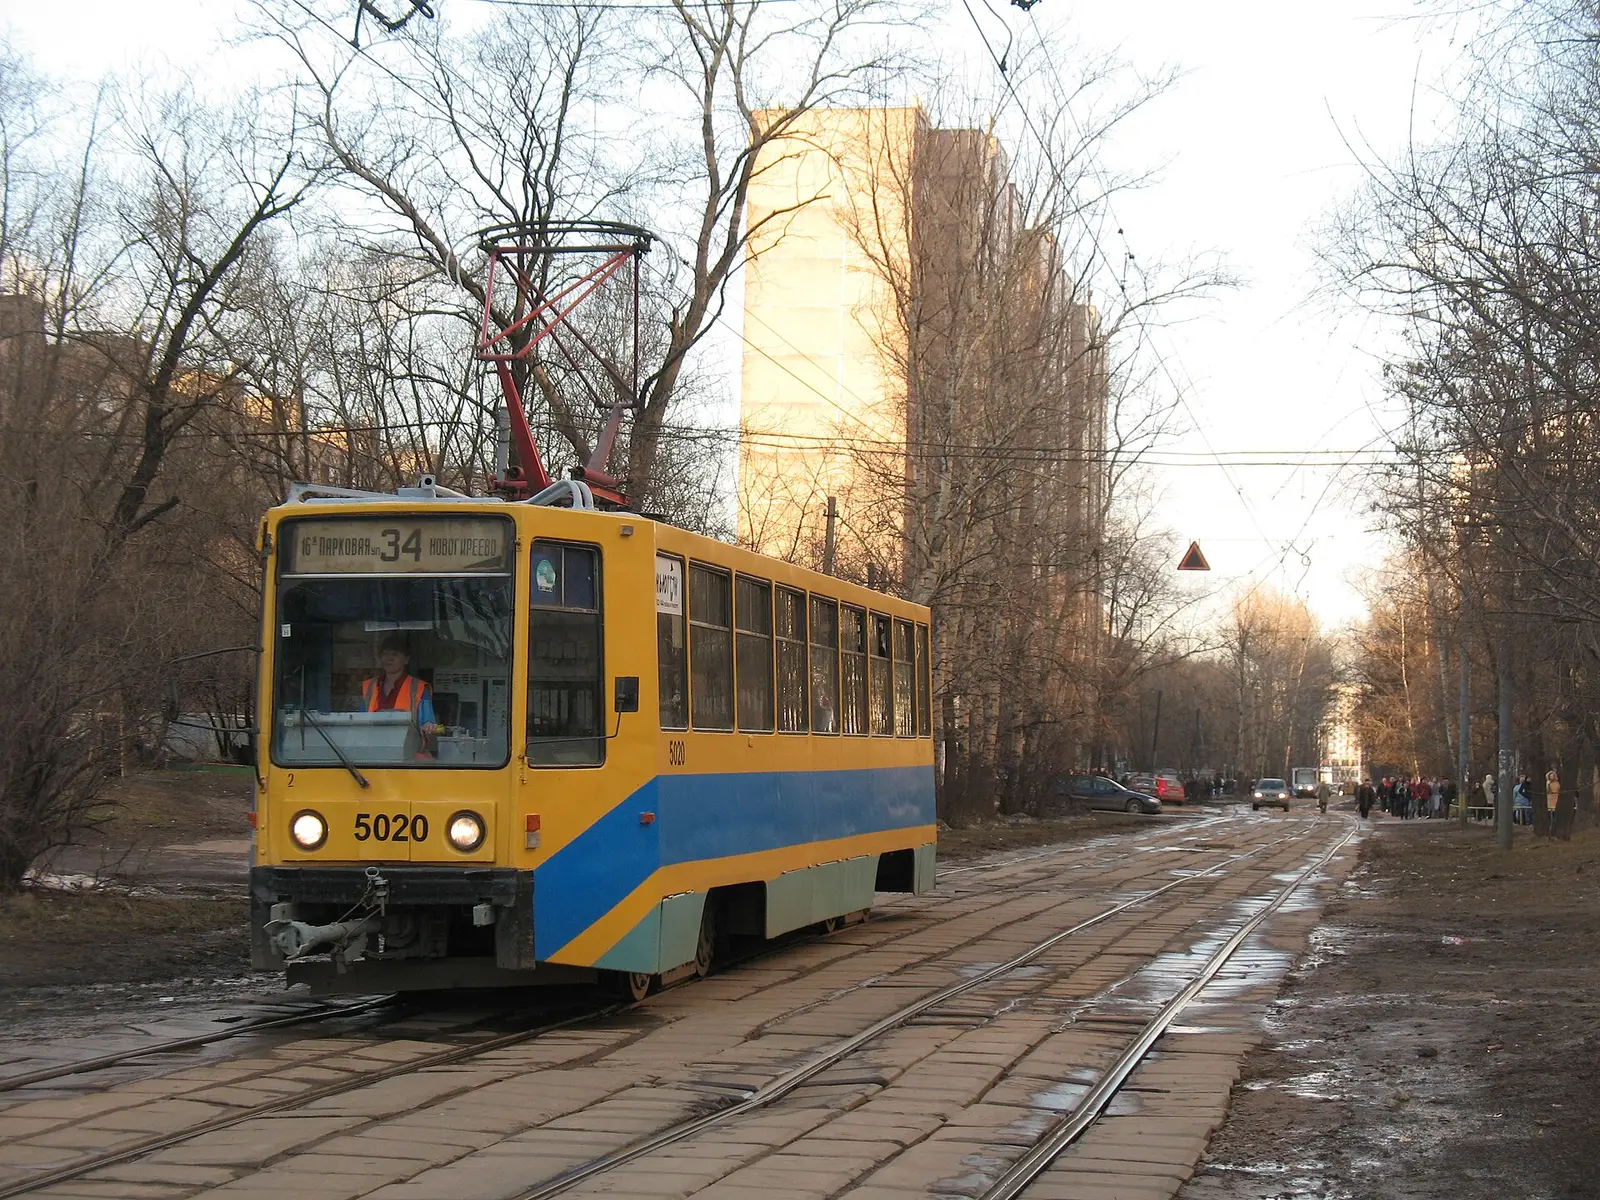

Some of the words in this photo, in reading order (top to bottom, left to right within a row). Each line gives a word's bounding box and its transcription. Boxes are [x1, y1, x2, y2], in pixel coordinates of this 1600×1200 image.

[319, 537, 371, 556] ПАРКОВАЯ
[380, 528, 422, 562] 34
[429, 537, 497, 557] НОВОГИРЕЕВО
[670, 741, 685, 766] 5020
[287, 773, 295, 788] 2
[353, 813, 429, 842] 5020
